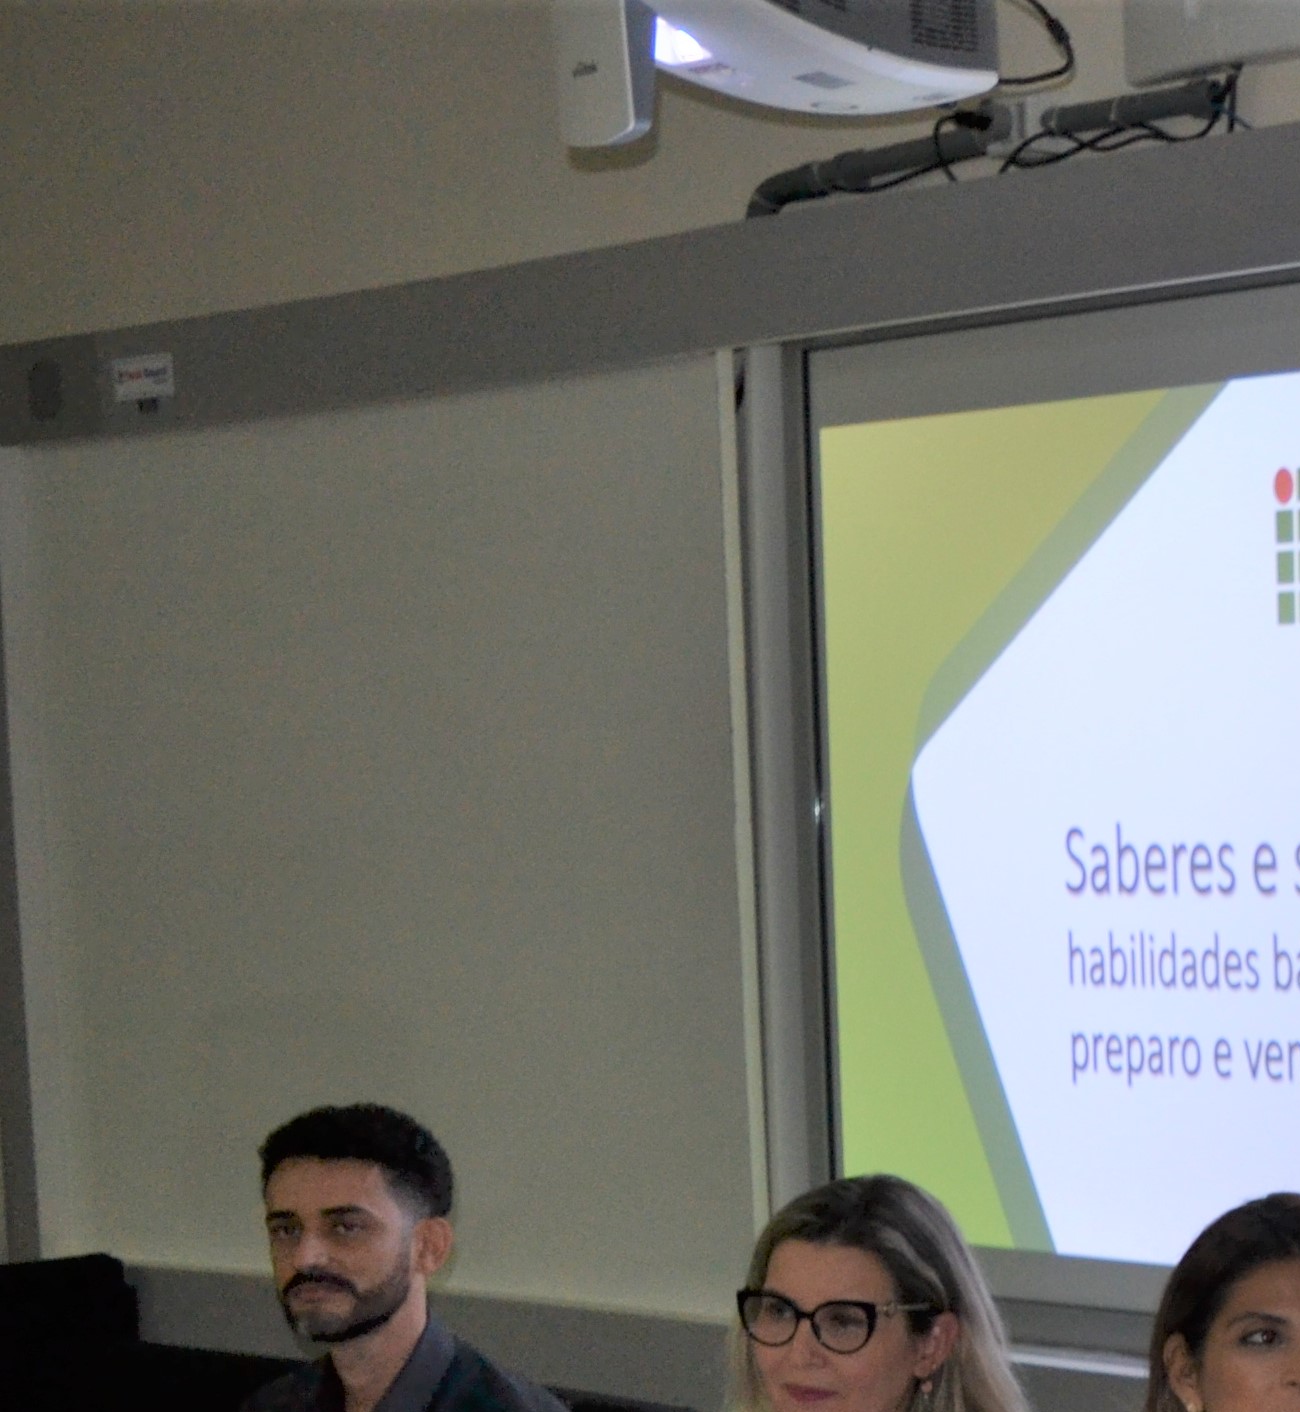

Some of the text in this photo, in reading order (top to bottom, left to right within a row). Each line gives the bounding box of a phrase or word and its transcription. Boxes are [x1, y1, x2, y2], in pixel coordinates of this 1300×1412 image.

[1064, 821, 1238, 898] Saberes
[1252, 841, 1279, 897] e
[1066, 928, 1261, 993] habilidades
[1069, 1029, 1202, 1088] preparo
[1212, 1036, 1234, 1081] e
